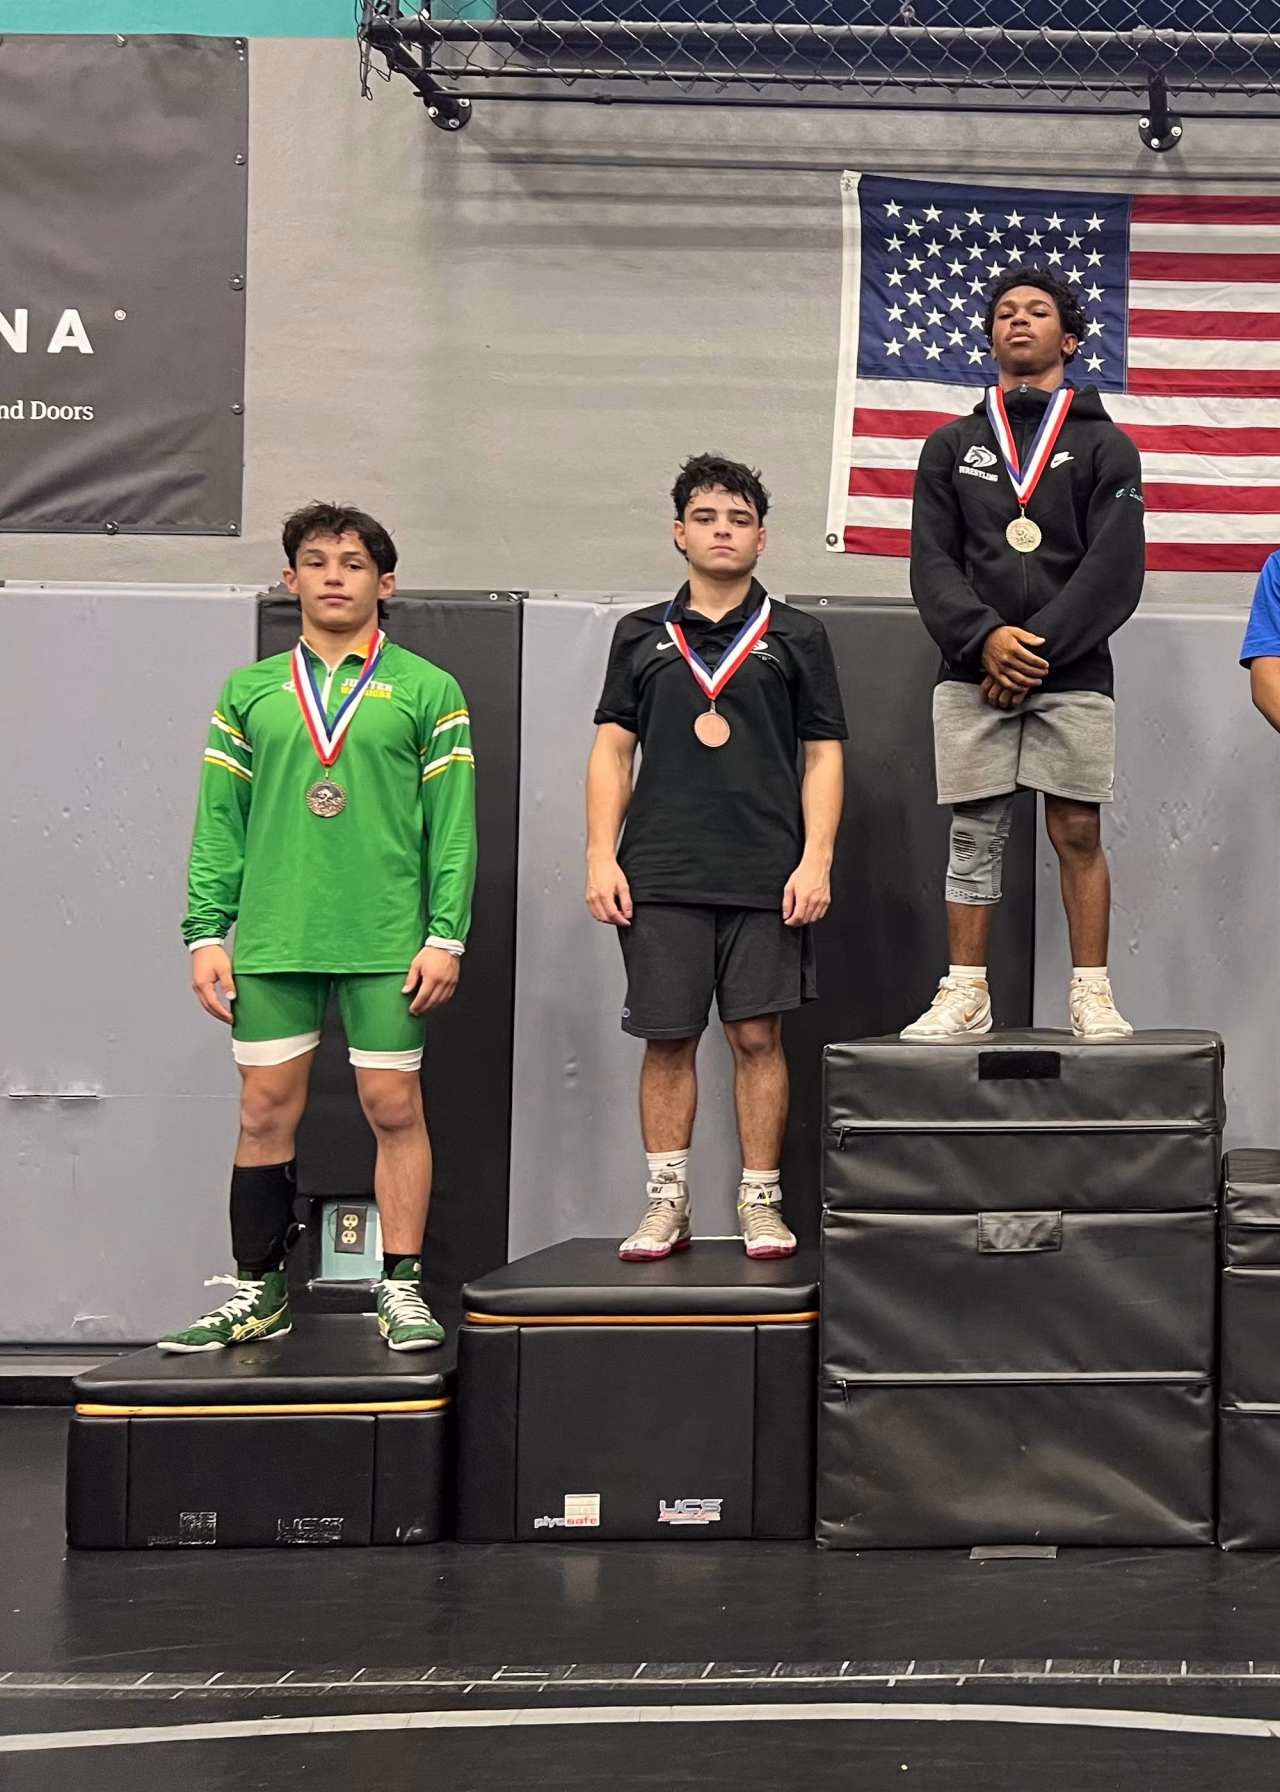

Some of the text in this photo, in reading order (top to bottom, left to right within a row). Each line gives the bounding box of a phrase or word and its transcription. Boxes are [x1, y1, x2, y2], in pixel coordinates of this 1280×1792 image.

[29, 400, 94, 420] Doors
[958, 465, 999, 482] WRESTLING
[660, 1499, 723, 1513] UCS
